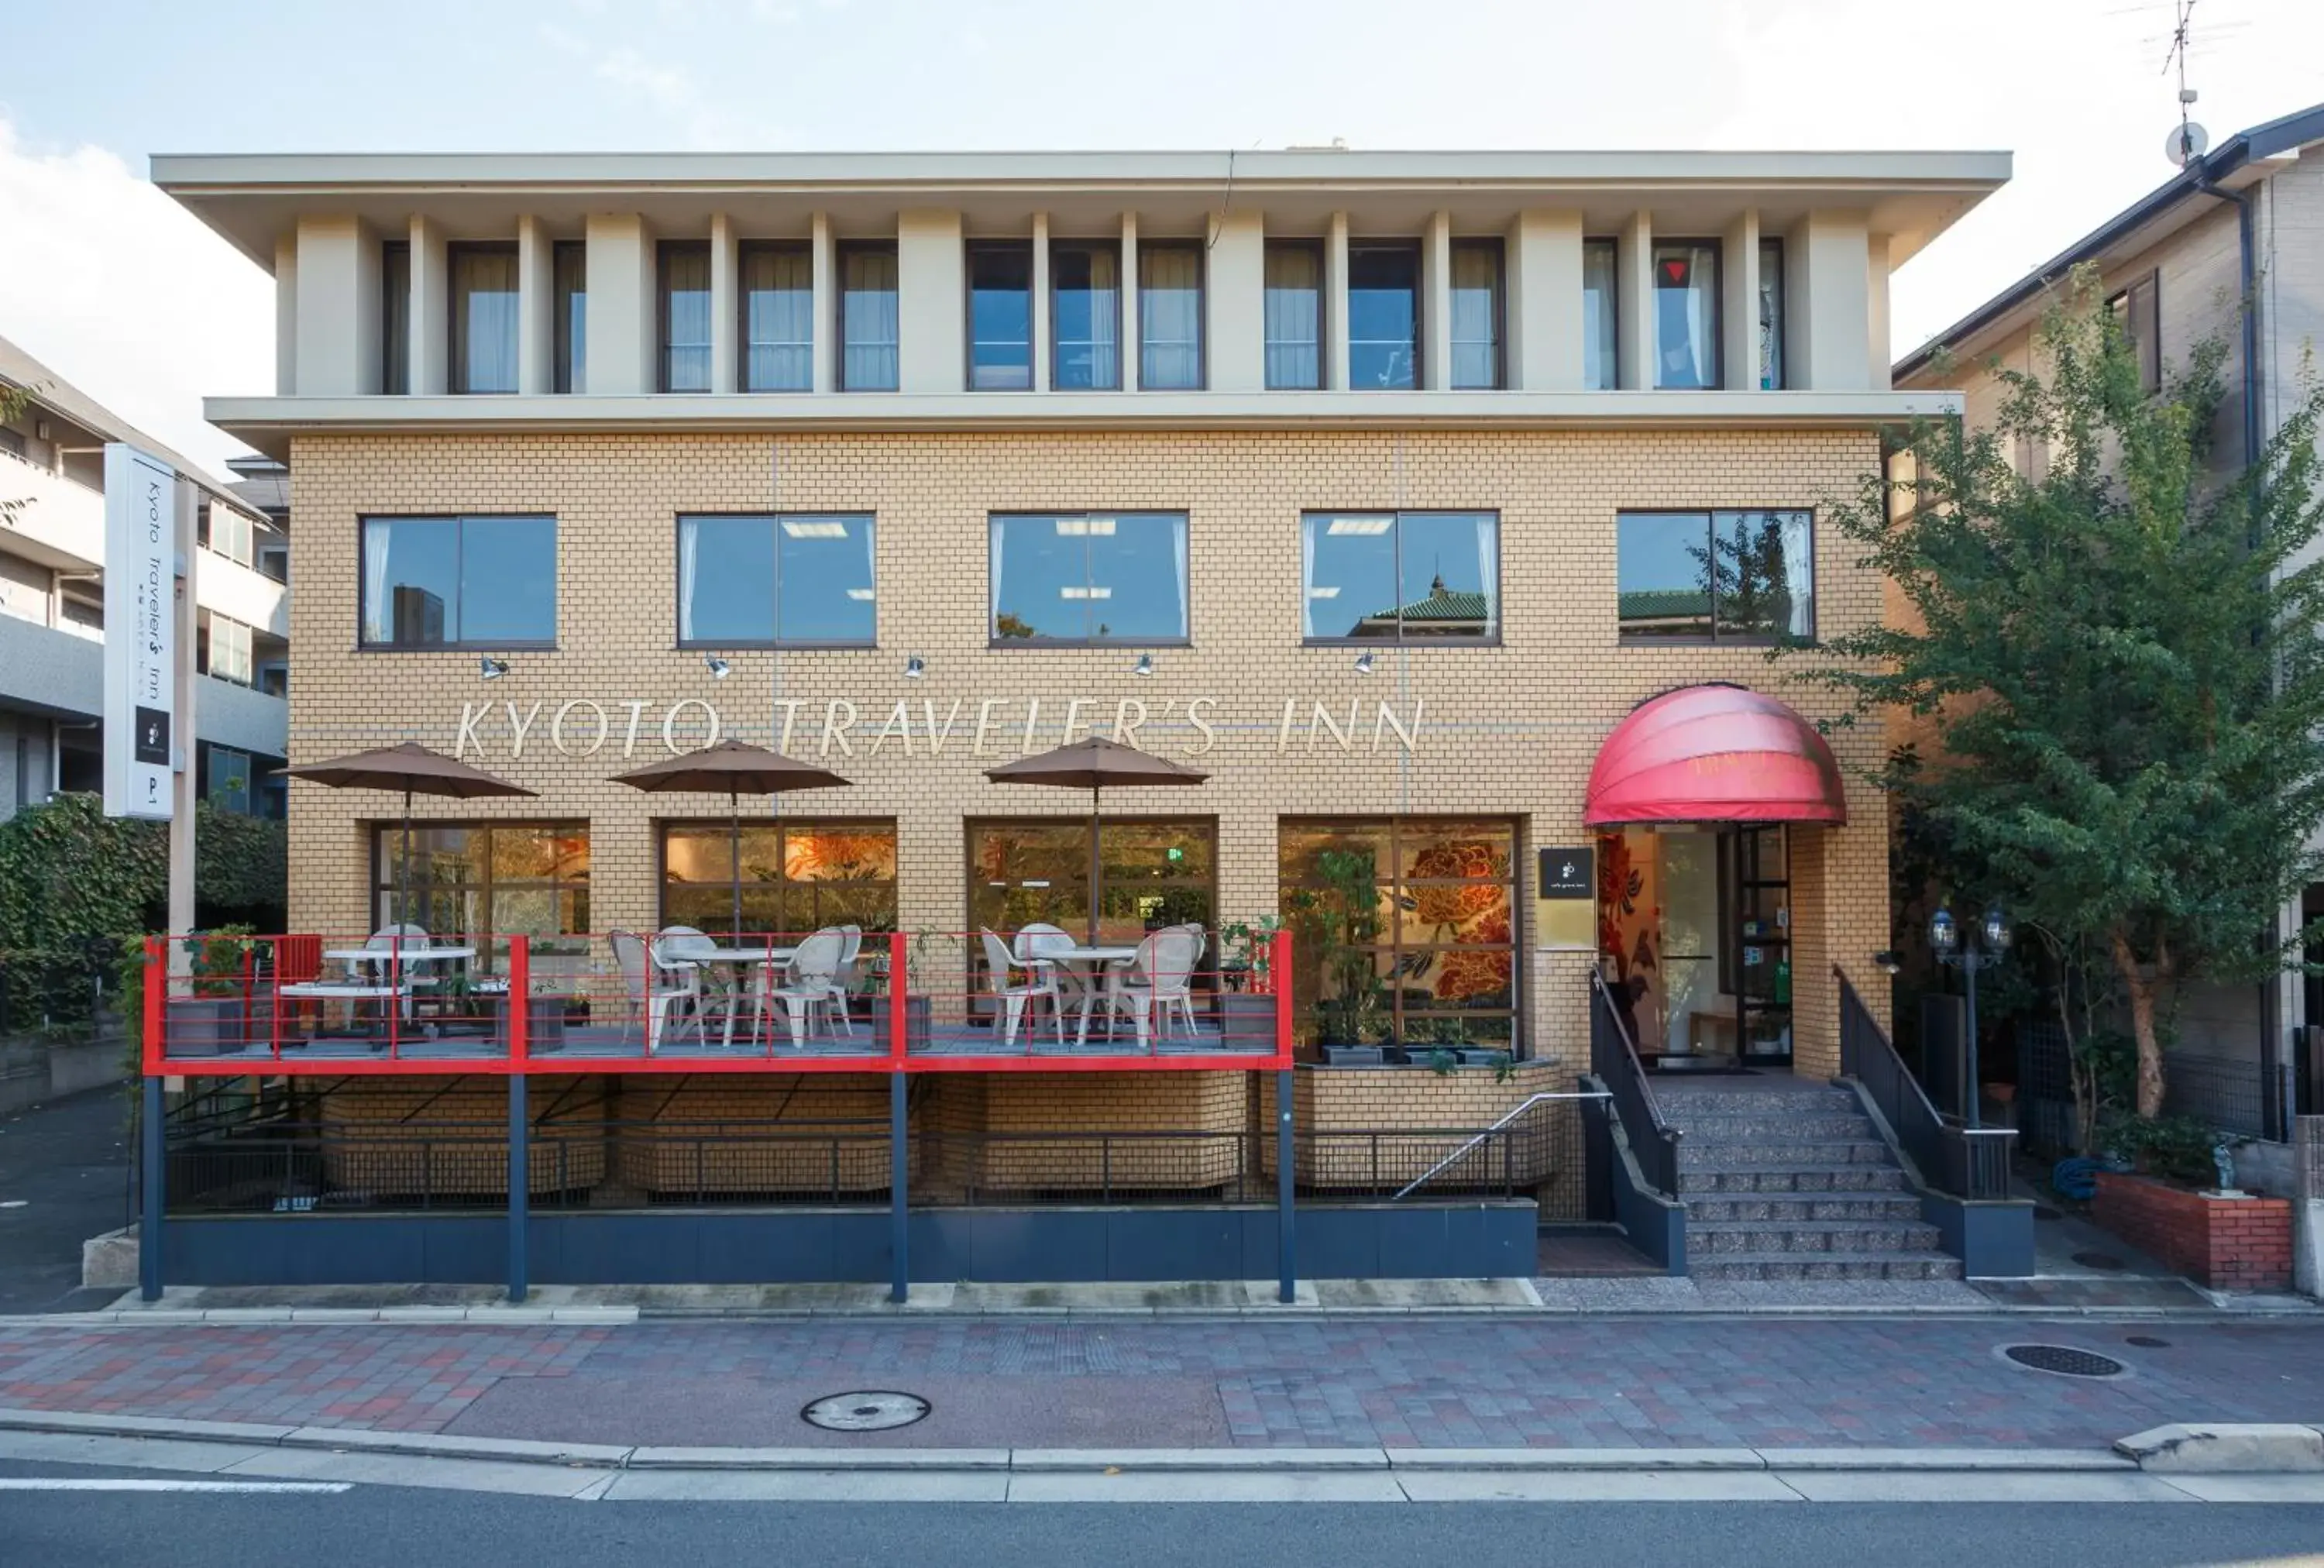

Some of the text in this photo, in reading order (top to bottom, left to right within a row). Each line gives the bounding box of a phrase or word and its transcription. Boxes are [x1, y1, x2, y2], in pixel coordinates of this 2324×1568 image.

[148, 481, 160, 543] Kyoto
[149, 666, 160, 700] Inn
[454, 698, 1423, 758] KYOTO TRAVELER'S INN
